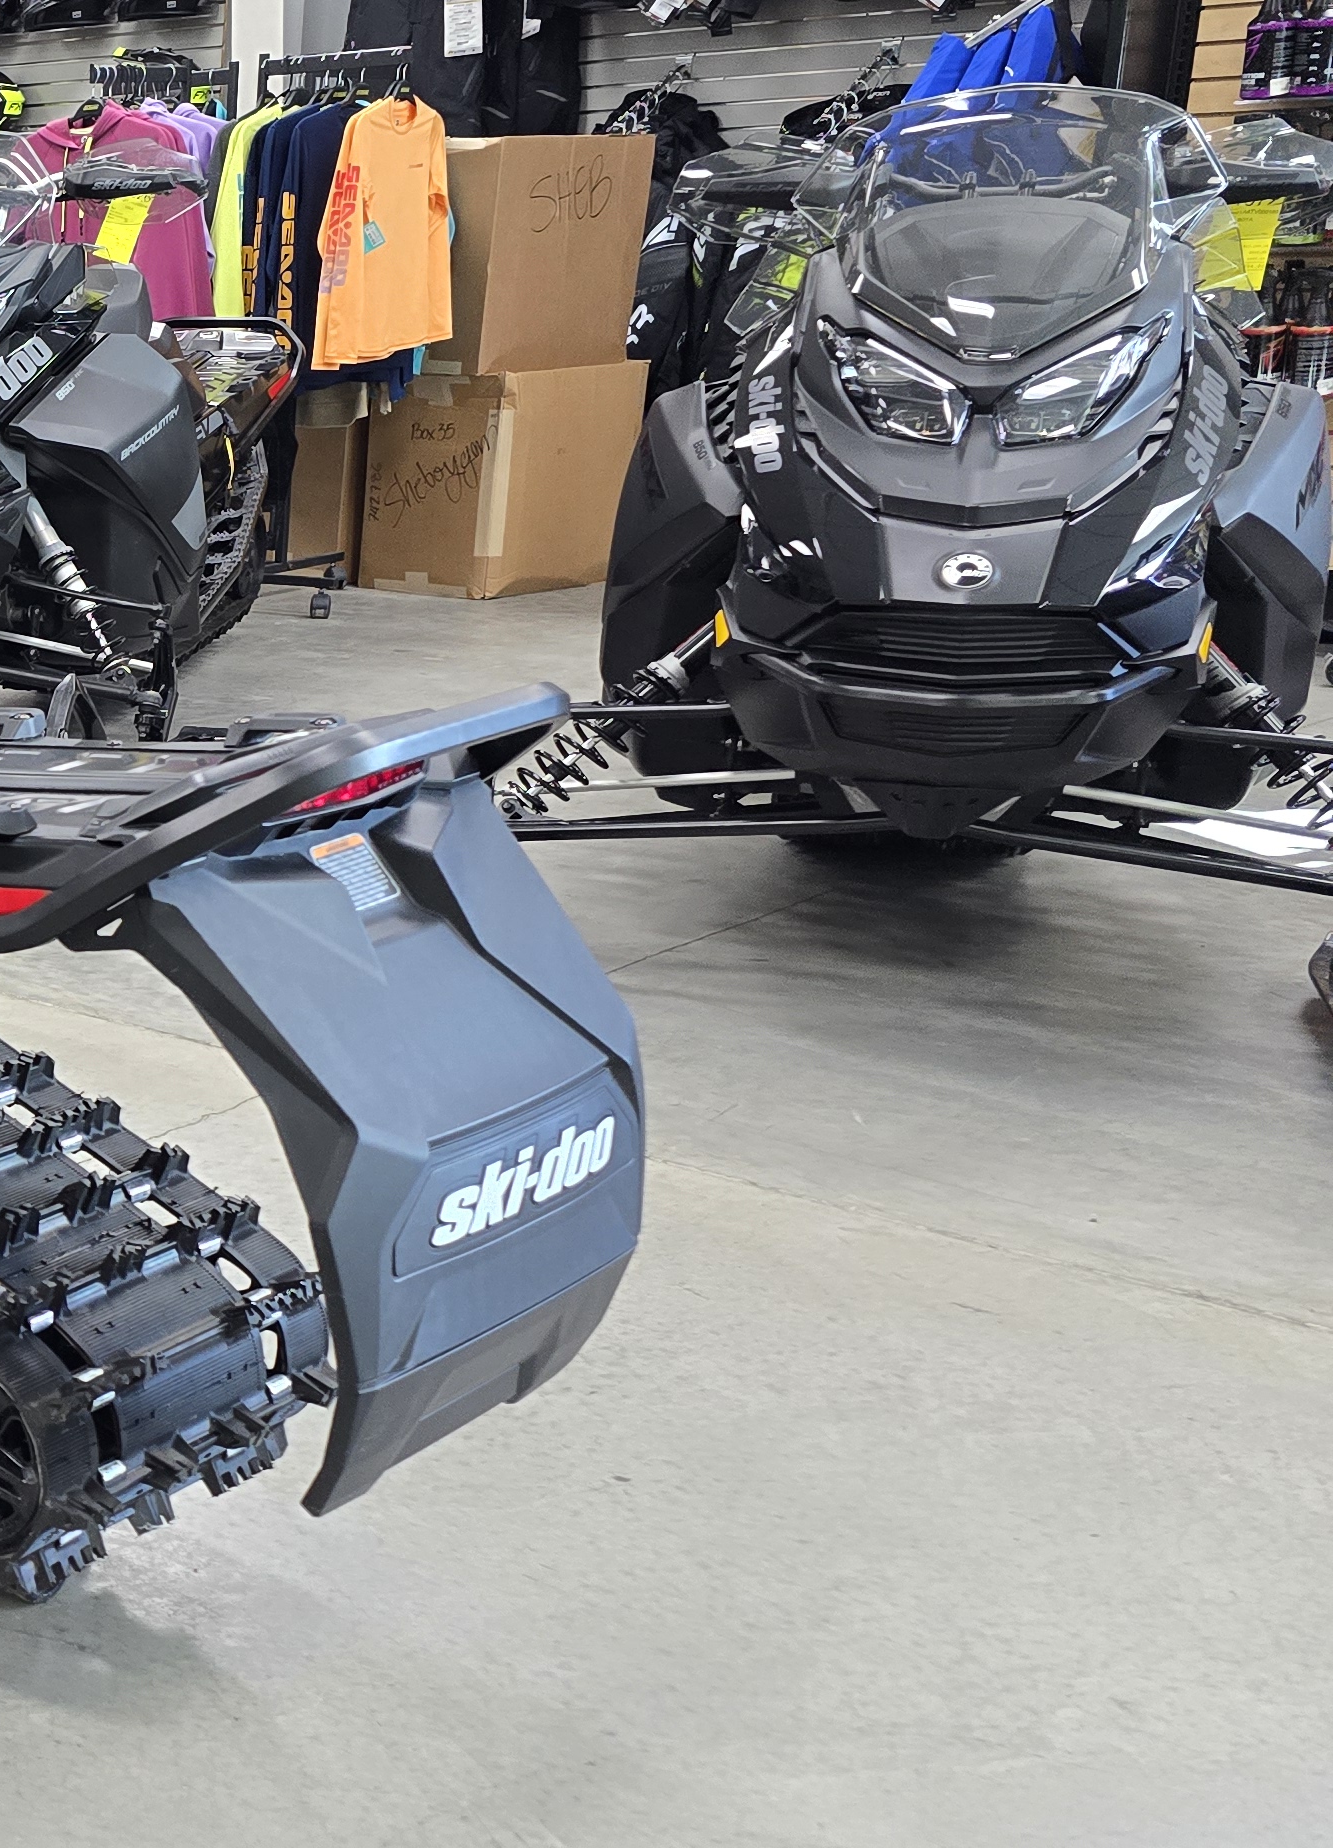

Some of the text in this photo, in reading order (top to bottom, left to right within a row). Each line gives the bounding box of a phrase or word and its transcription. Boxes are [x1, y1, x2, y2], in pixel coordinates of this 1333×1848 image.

[92, 180, 153, 191] ski-doo
[55, 380, 76, 401] 850
[120, 404, 180, 461] BACKCOUNTRY
[411, 422, 455, 440] Box 35
[748, 375, 785, 473] ski-doo
[1184, 364, 1229, 486] ski-doo
[430, 1114, 616, 1248] ski-doo
